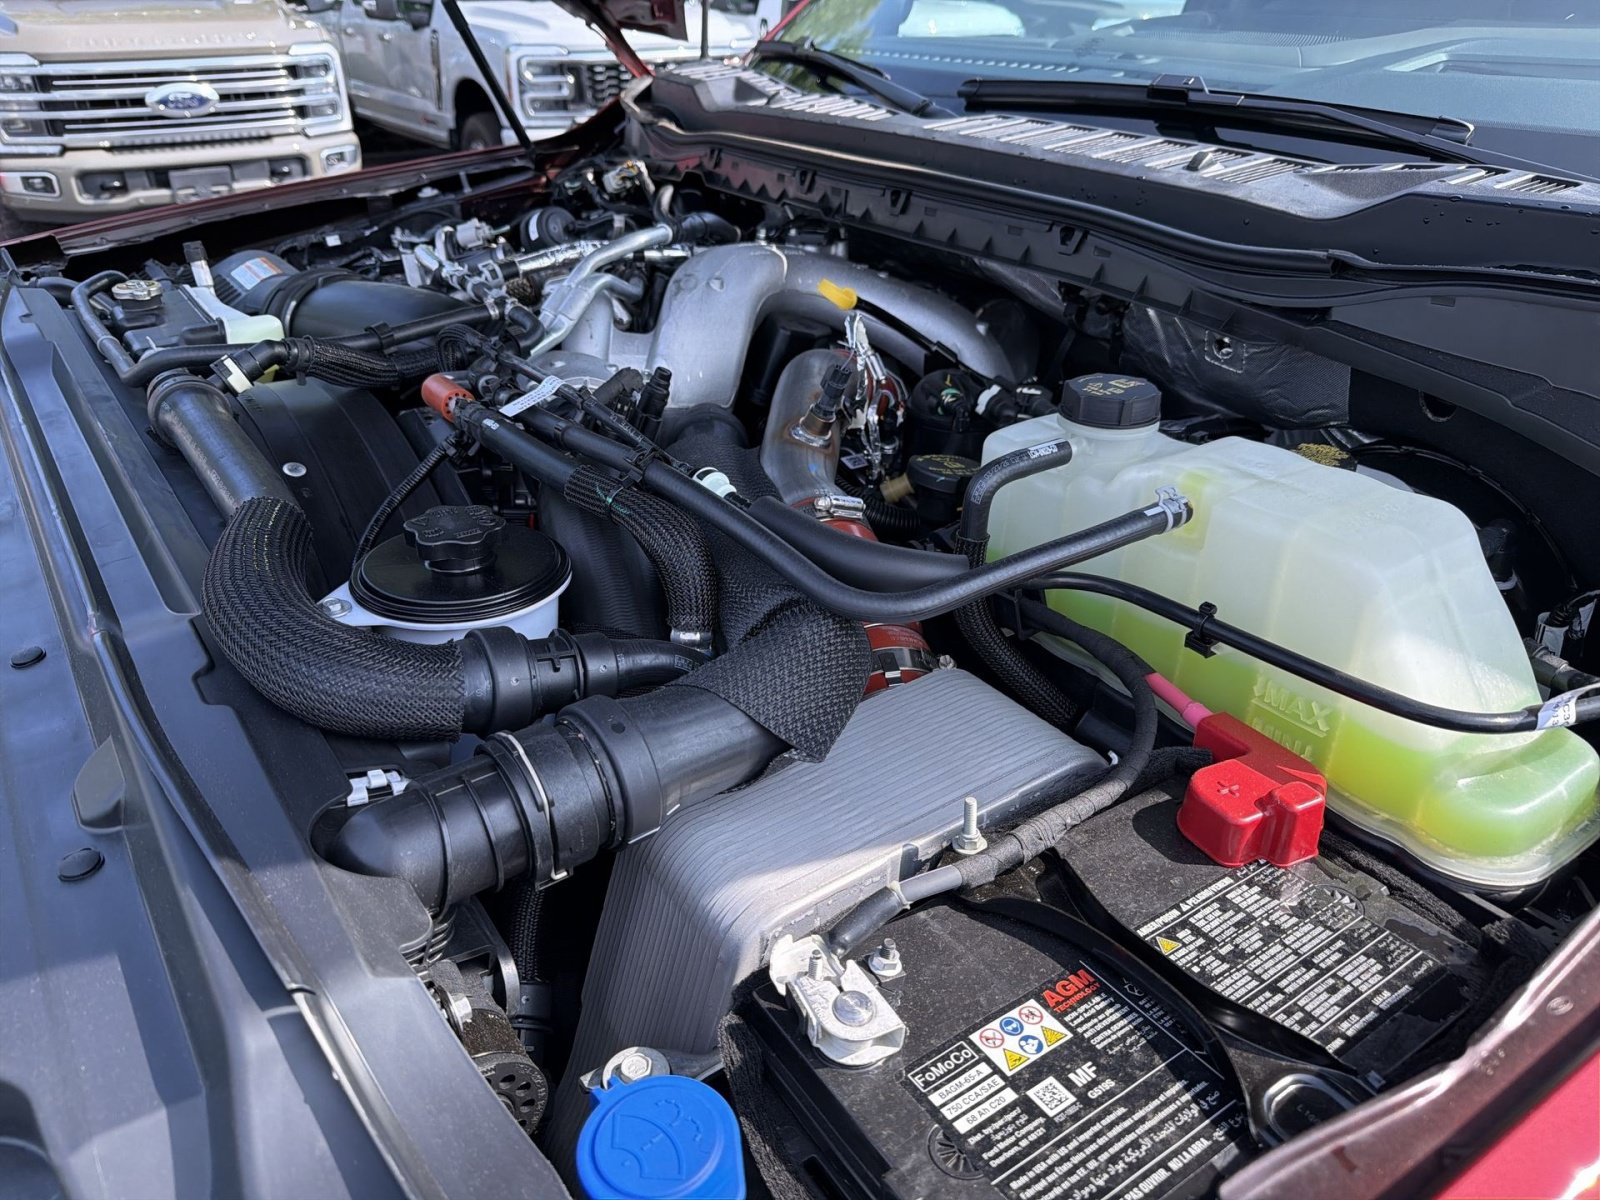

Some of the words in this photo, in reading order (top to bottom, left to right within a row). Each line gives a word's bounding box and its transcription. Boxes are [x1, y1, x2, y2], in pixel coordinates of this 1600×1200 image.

[1264, 680, 1332, 731] MAX
[1036, 968, 1095, 1007] AGM
[1052, 981, 1101, 1013] TECHNOLOGY
[1062, 992, 1107, 1022] NON-SPILLABLE
[1068, 1015, 1084, 1026] Lead
[1081, 1007, 1096, 1017] Acid
[1093, 996, 1115, 1011] Battery
[1082, 1027, 1097, 1038] ANTI
[1089, 1028, 1112, 1045] CONTRA
[913, 1046, 973, 1087] FoMoCo
[1067, 1059, 1102, 1088] MF
[937, 1068, 983, 1099] BAGM-65-A
[945, 1101, 963, 1115] 750
[960, 1077, 1000, 1106] CCA/SAE
[1085, 1076, 1116, 1101] G519S
[965, 1113, 978, 1125] 68
[976, 1105, 990, 1118] Ah
[987, 1095, 1006, 1110] C20
[966, 1130, 985, 1146] Dist.
[981, 1145, 999, 1160] Ford
[996, 1133, 1017, 1151] Motor
[1018, 1137, 1030, 1148] MI
[1026, 1125, 1046, 1143] 48121
[1008, 1173, 1030, 1190] Made
[1025, 1169, 1035, 1178] in
[1031, 1160, 1048, 1174] USA
[1044, 1152, 1059, 1165] with
[1056, 1145, 1069, 1156] US
[1065, 1138, 1080, 1150] and
[1075, 1122, 1103, 1143] imported
[1137, 1165, 1172, 1194] OUVRIR.
[1166, 1156, 1184, 1172] NO
[1177, 1149, 1193, 1164] LA
[1186, 1134, 1213, 1157] ABRA.
